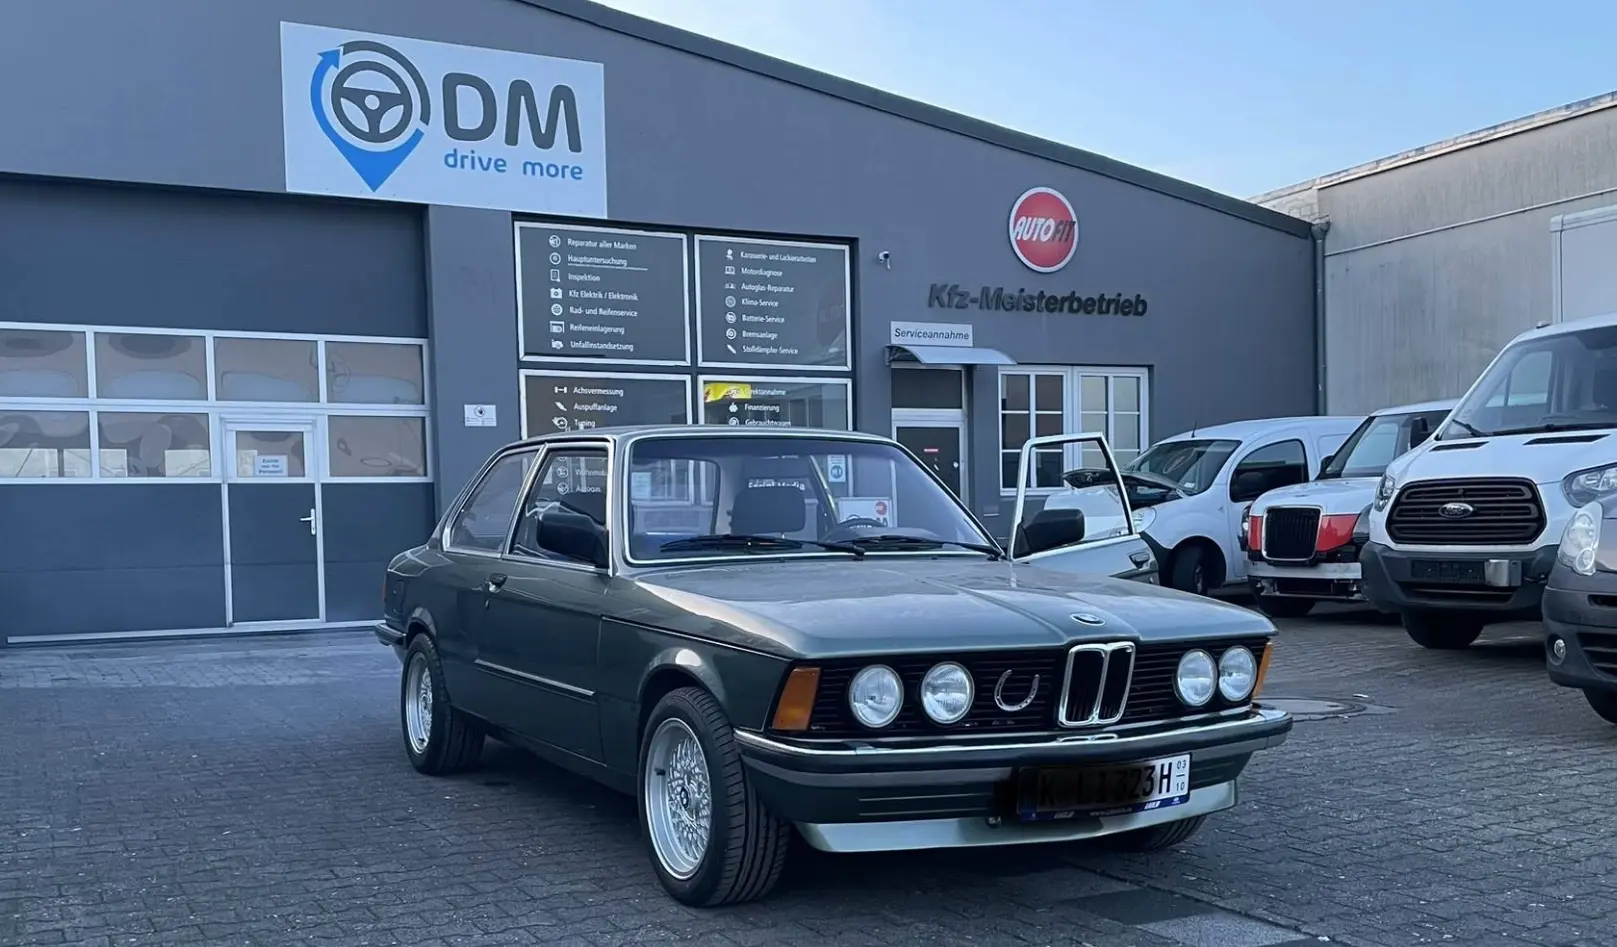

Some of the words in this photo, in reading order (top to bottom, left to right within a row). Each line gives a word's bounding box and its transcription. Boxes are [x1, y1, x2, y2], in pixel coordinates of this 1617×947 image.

[442, 72, 582, 153] DM
[444, 149, 507, 173] drive
[522, 160, 583, 181] more
[567, 238, 598, 249] Reparatur
[599, 240, 613, 249] aller
[614, 242, 637, 250] Marken
[568, 254, 627, 266] Hauptuntersuchung
[568, 273, 601, 283] Inspektion
[741, 267, 783, 278] Motordiagnose
[741, 283, 795, 294] Autoglas-Reparatur
[569, 289, 579, 298] Kfz
[580, 290, 603, 299] Elektrik
[608, 292, 639, 301] Elektronik
[928, 284, 1148, 317] Kfz-Meisterbetrieb
[741, 298, 779, 308] Klima-Service
[569, 306, 584, 315] Rad-
[599, 308, 638, 317] Reifenservice
[741, 314, 785, 324] Batterie-Service
[569, 323, 625, 335] Reifeneinlagerung
[894, 327, 970, 341] Serviceannahme
[742, 330, 778, 341] Bremsanlage
[570, 340, 634, 352] Unfallinstandsetzung
[573, 387, 624, 397] Achsvermessung
[573, 403, 618, 413] Auspuffanlage
[744, 403, 780, 413] Finanzierung
[574, 418, 596, 428] Tuning
[1176, 759, 1187, 770] 03
[1176, 782, 1186, 792] 10
